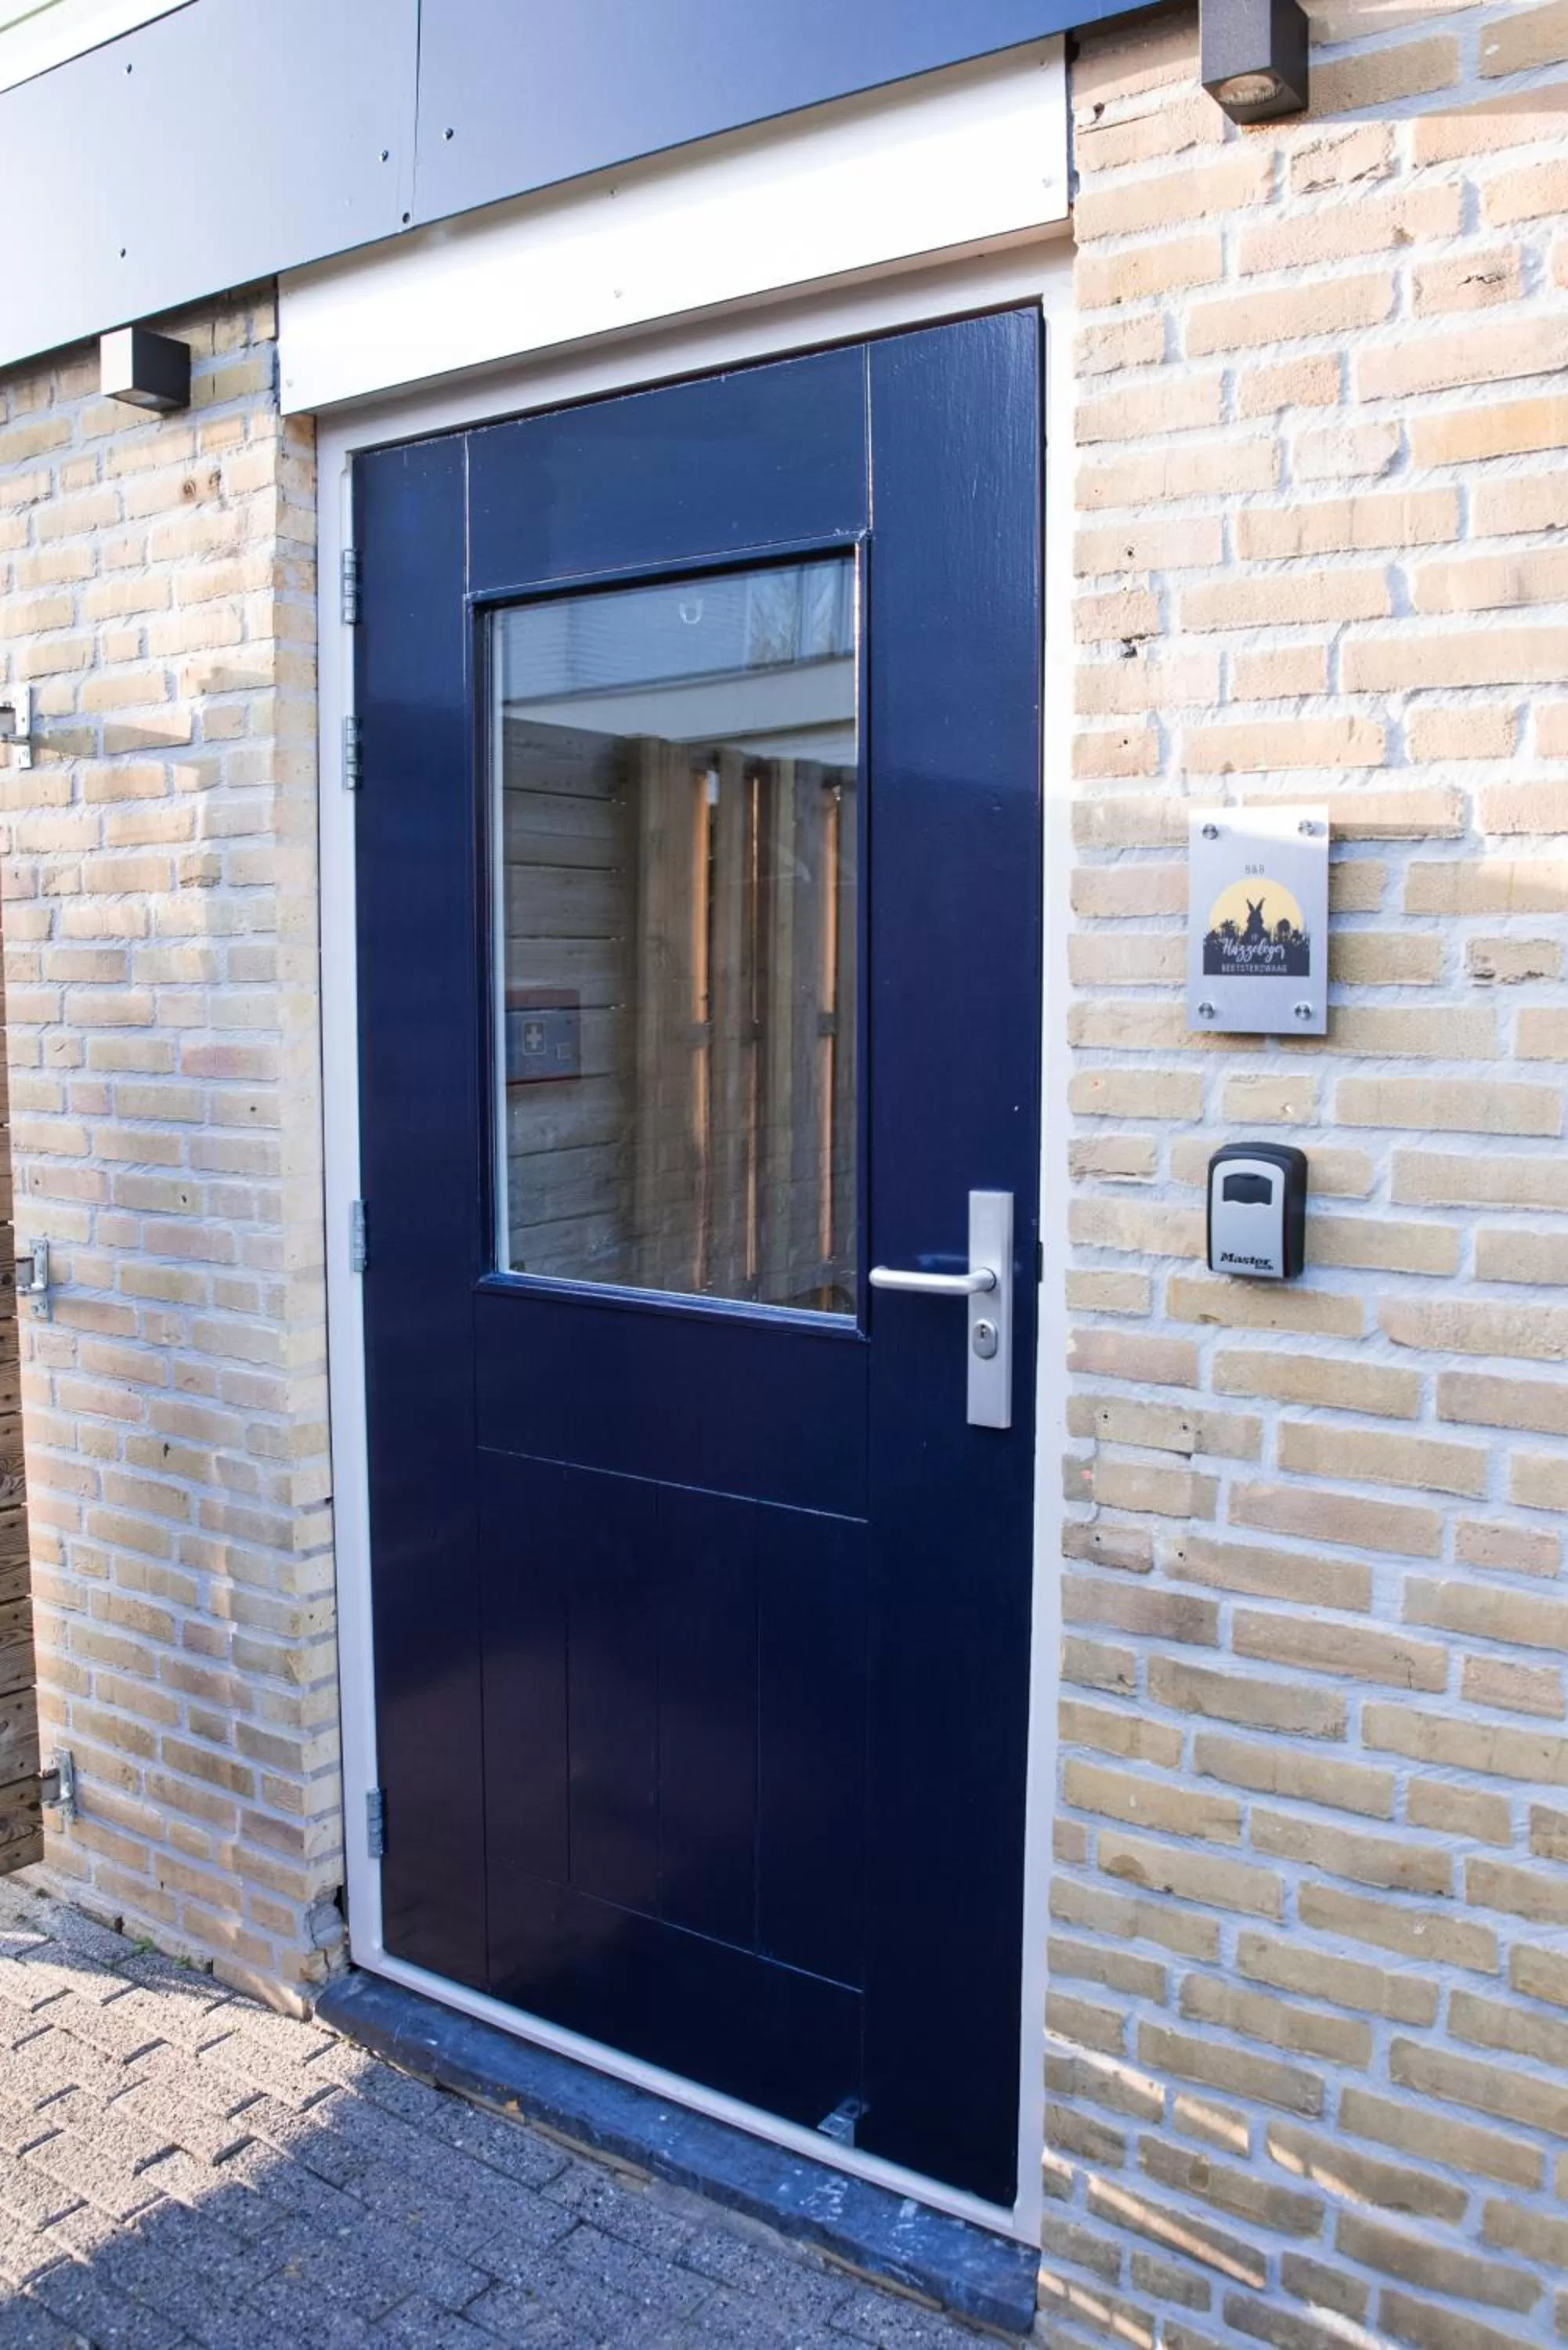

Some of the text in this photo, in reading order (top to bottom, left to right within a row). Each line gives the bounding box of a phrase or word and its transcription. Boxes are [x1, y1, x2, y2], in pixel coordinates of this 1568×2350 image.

[1245, 865, 1265, 874] B&B
[1222, 964, 1287, 974] BEETSTERZWAAG
[1219, 1253, 1270, 1265] Master
